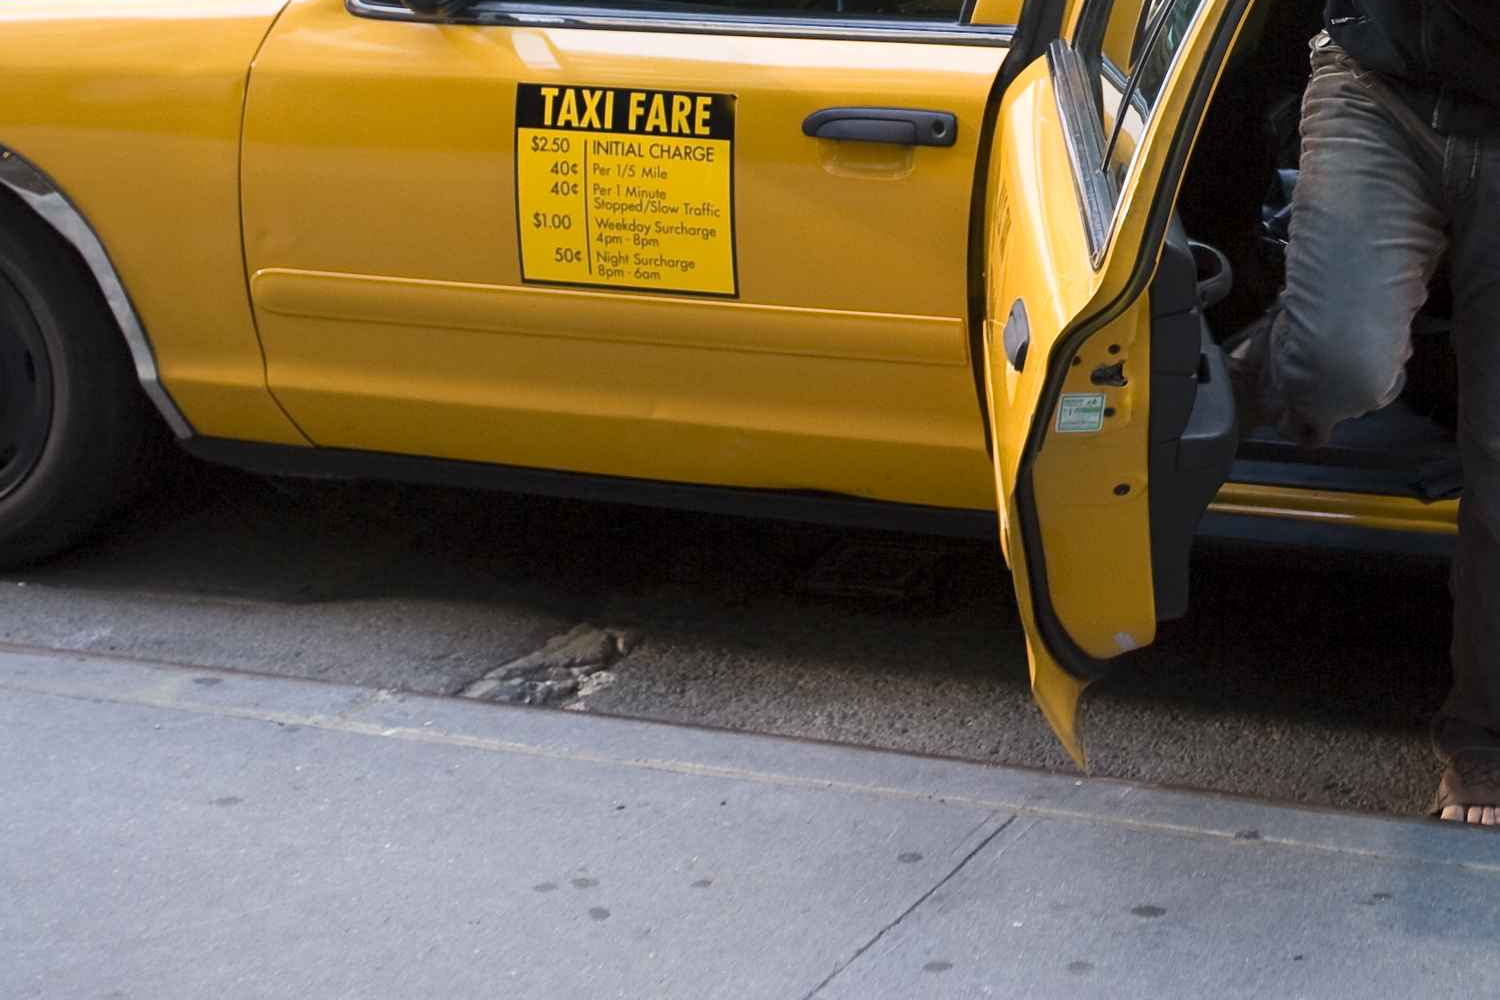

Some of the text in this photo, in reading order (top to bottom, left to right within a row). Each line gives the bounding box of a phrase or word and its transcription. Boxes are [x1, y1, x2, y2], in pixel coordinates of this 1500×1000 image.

[540, 86, 713, 136] TAXI FARE
[531, 135, 570, 154] $2.50
[592, 140, 715, 163] INITIAL CHARGE
[550, 161, 579, 176] 40¢
[592, 163, 668, 180] Per 1/5 Mile
[550, 181, 579, 196] 40¢
[593, 183, 612, 197] Per
[625, 185, 667, 200] Minute
[593, 198, 721, 218] Stopped/Slow Traffic
[533, 212, 572, 230] $1.00
[595, 217, 717, 240] Weekday Surcharge
[596, 233, 623, 247] 4pm
[633, 234, 660, 248] 8pm
[554, 247, 582, 263] 50¢
[596, 251, 696, 272] Night Surcharge
[598, 265, 625, 279] 8pm
[634, 267, 661, 281] 6am
